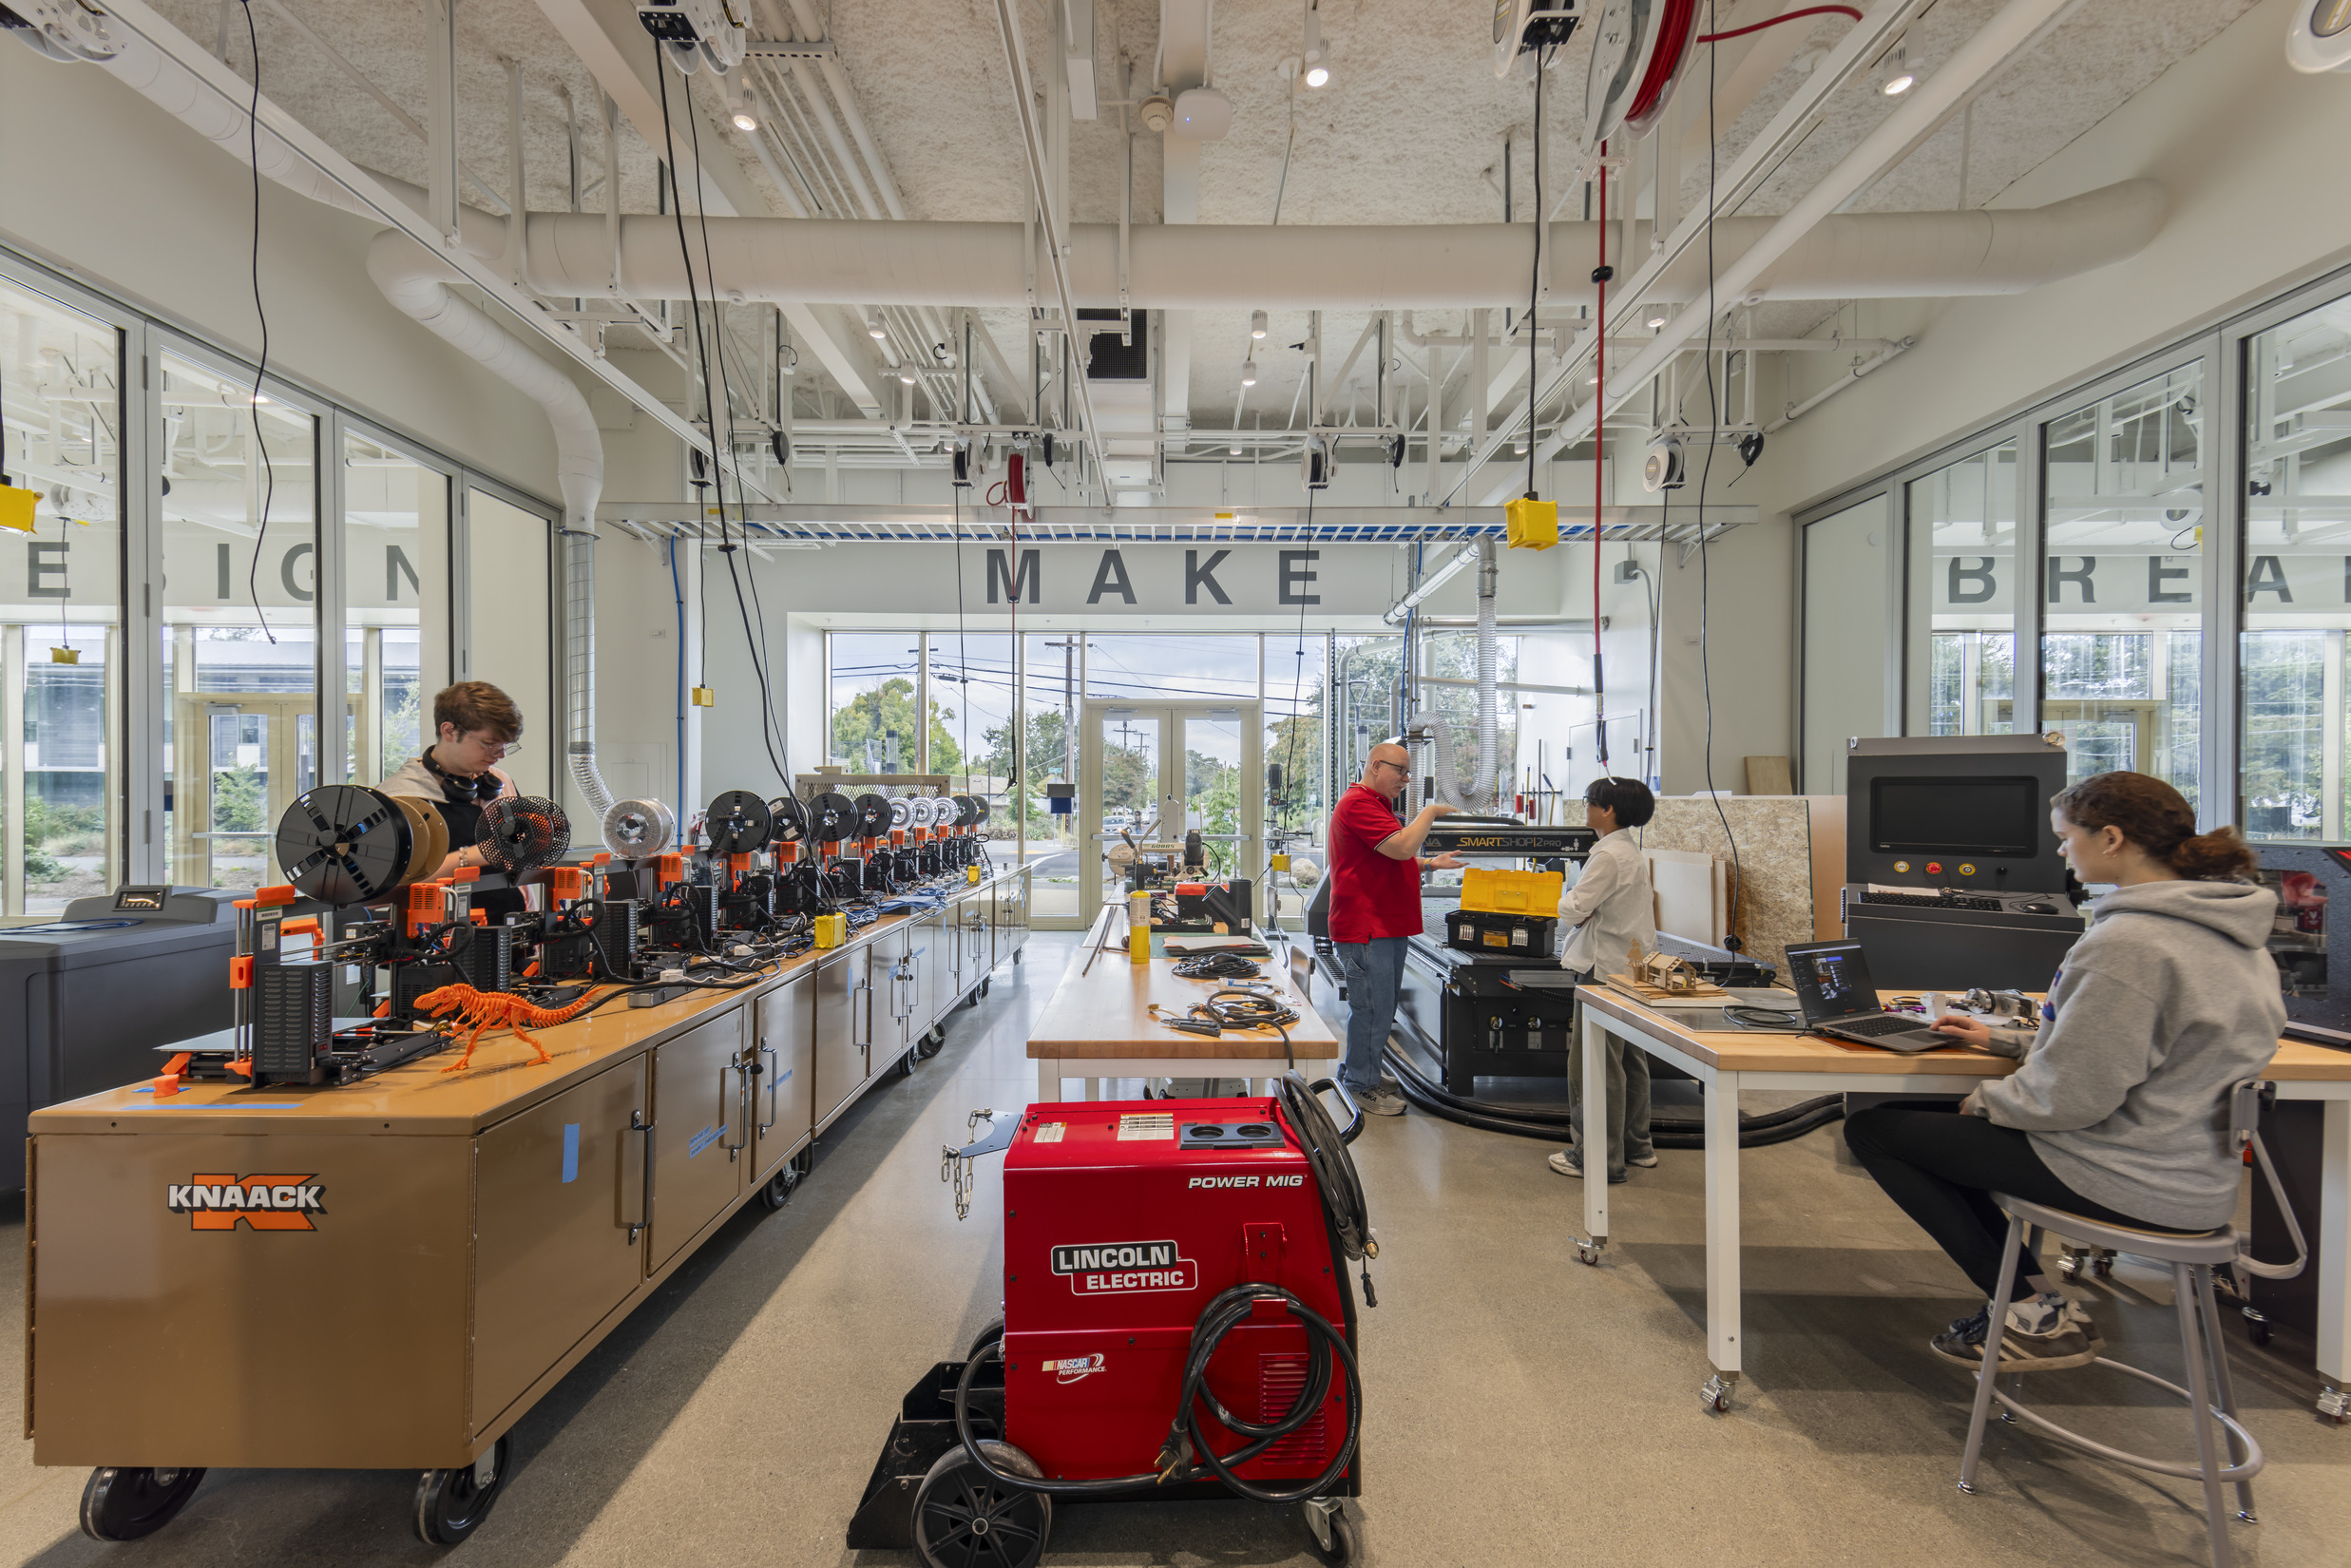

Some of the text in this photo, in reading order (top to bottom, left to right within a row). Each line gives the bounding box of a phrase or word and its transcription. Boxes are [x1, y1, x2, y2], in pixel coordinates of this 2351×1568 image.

[986, 548, 1321, 605] MAKE
[1948, 555, 2351, 604] BREA
[1188, 1175, 1304, 1189] POWER MIG
[168, 1184, 324, 1211] KNAACK
[1059, 1245, 1170, 1271] LINCOLN
[1086, 1271, 1184, 1290] ELECTRIC
[1057, 1357, 1088, 1370] NASCAR
[1059, 1366, 1106, 1376] PERFORMANCE
